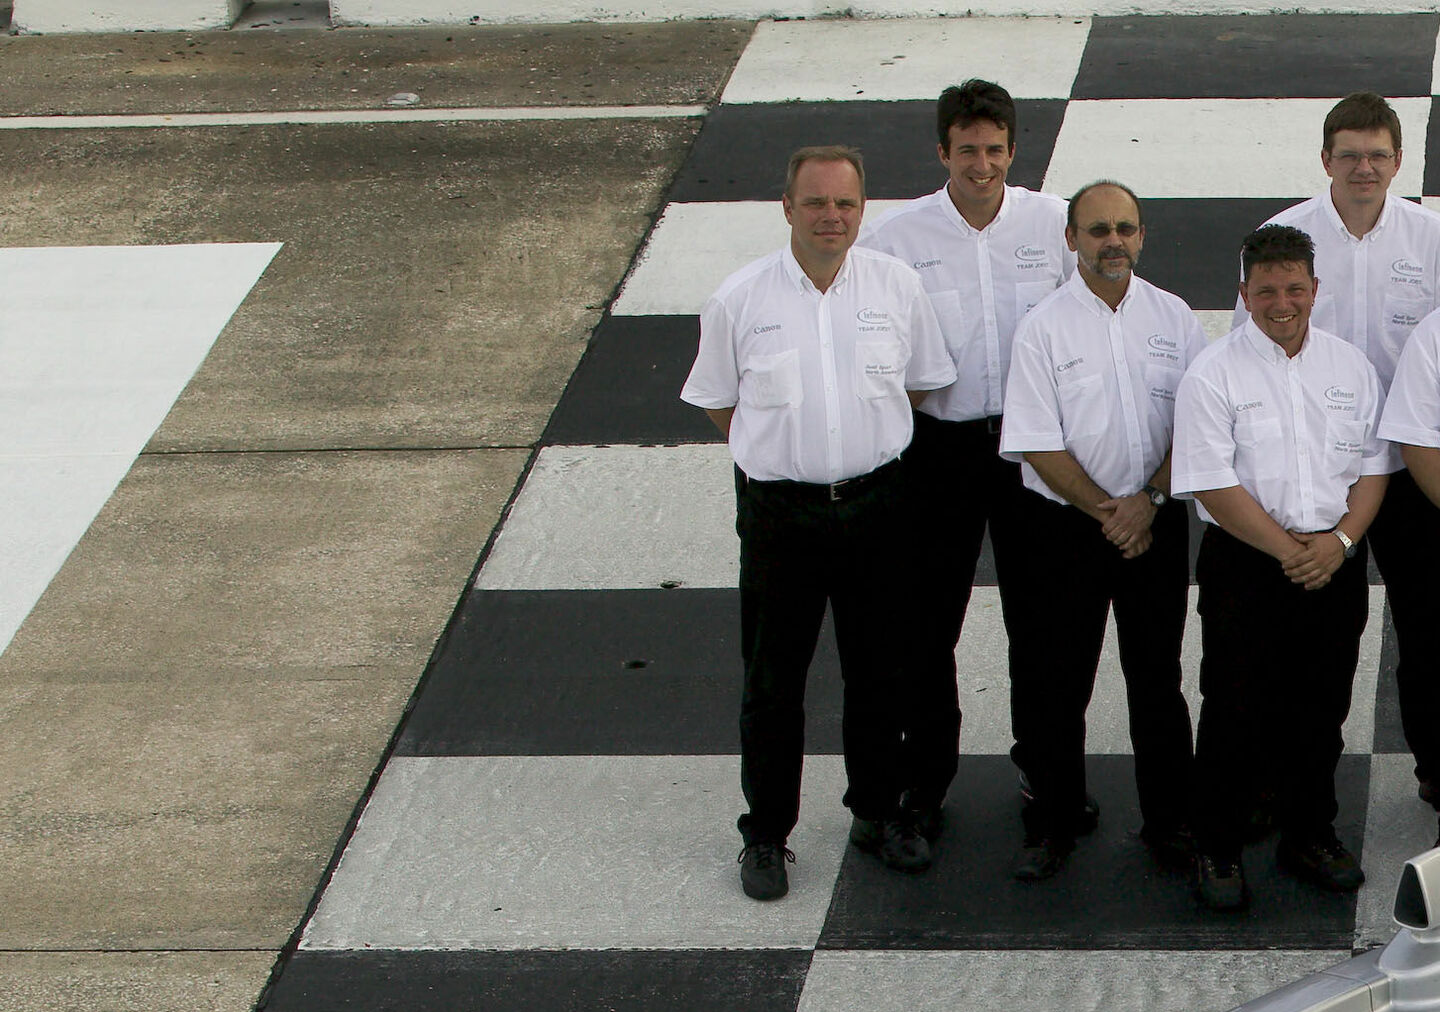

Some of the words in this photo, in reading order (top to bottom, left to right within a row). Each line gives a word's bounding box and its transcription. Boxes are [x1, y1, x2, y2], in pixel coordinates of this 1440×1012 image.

[914, 259, 942, 269] Canon
[754, 323, 782, 334] Canon
[1057, 358, 1083, 372] Canon
[1236, 401, 1263, 412] Canon
